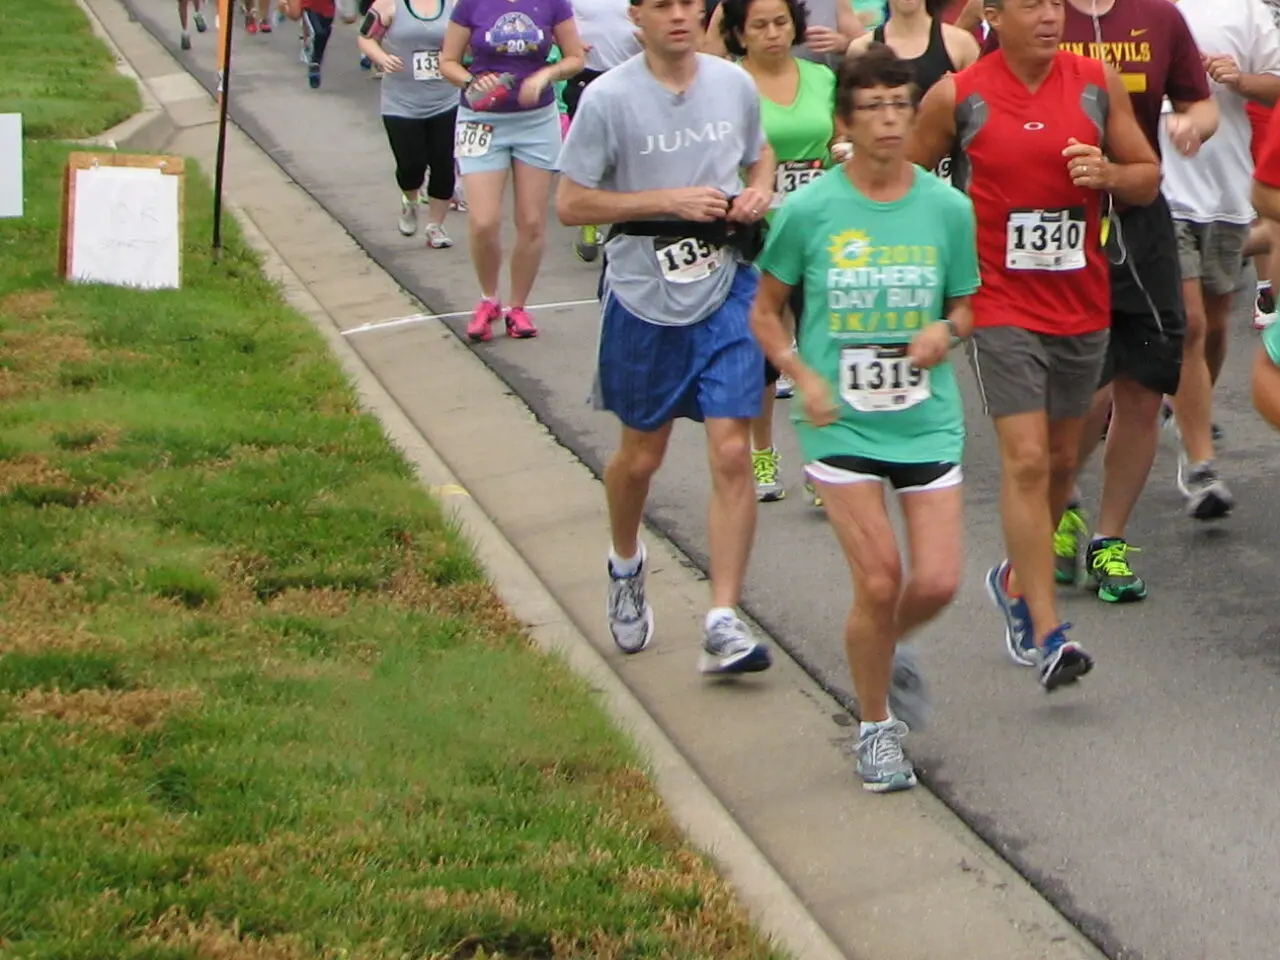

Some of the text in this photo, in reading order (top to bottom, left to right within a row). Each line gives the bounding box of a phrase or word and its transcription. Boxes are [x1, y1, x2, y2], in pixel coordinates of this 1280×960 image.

[507, 40, 526, 53] 20
[1088, 42, 1151, 62] DEVILS
[639, 121, 734, 155] JUMP
[1013, 223, 1081, 251] 1340
[828, 289, 880, 308] DAY
[847, 361, 923, 390] 1319
